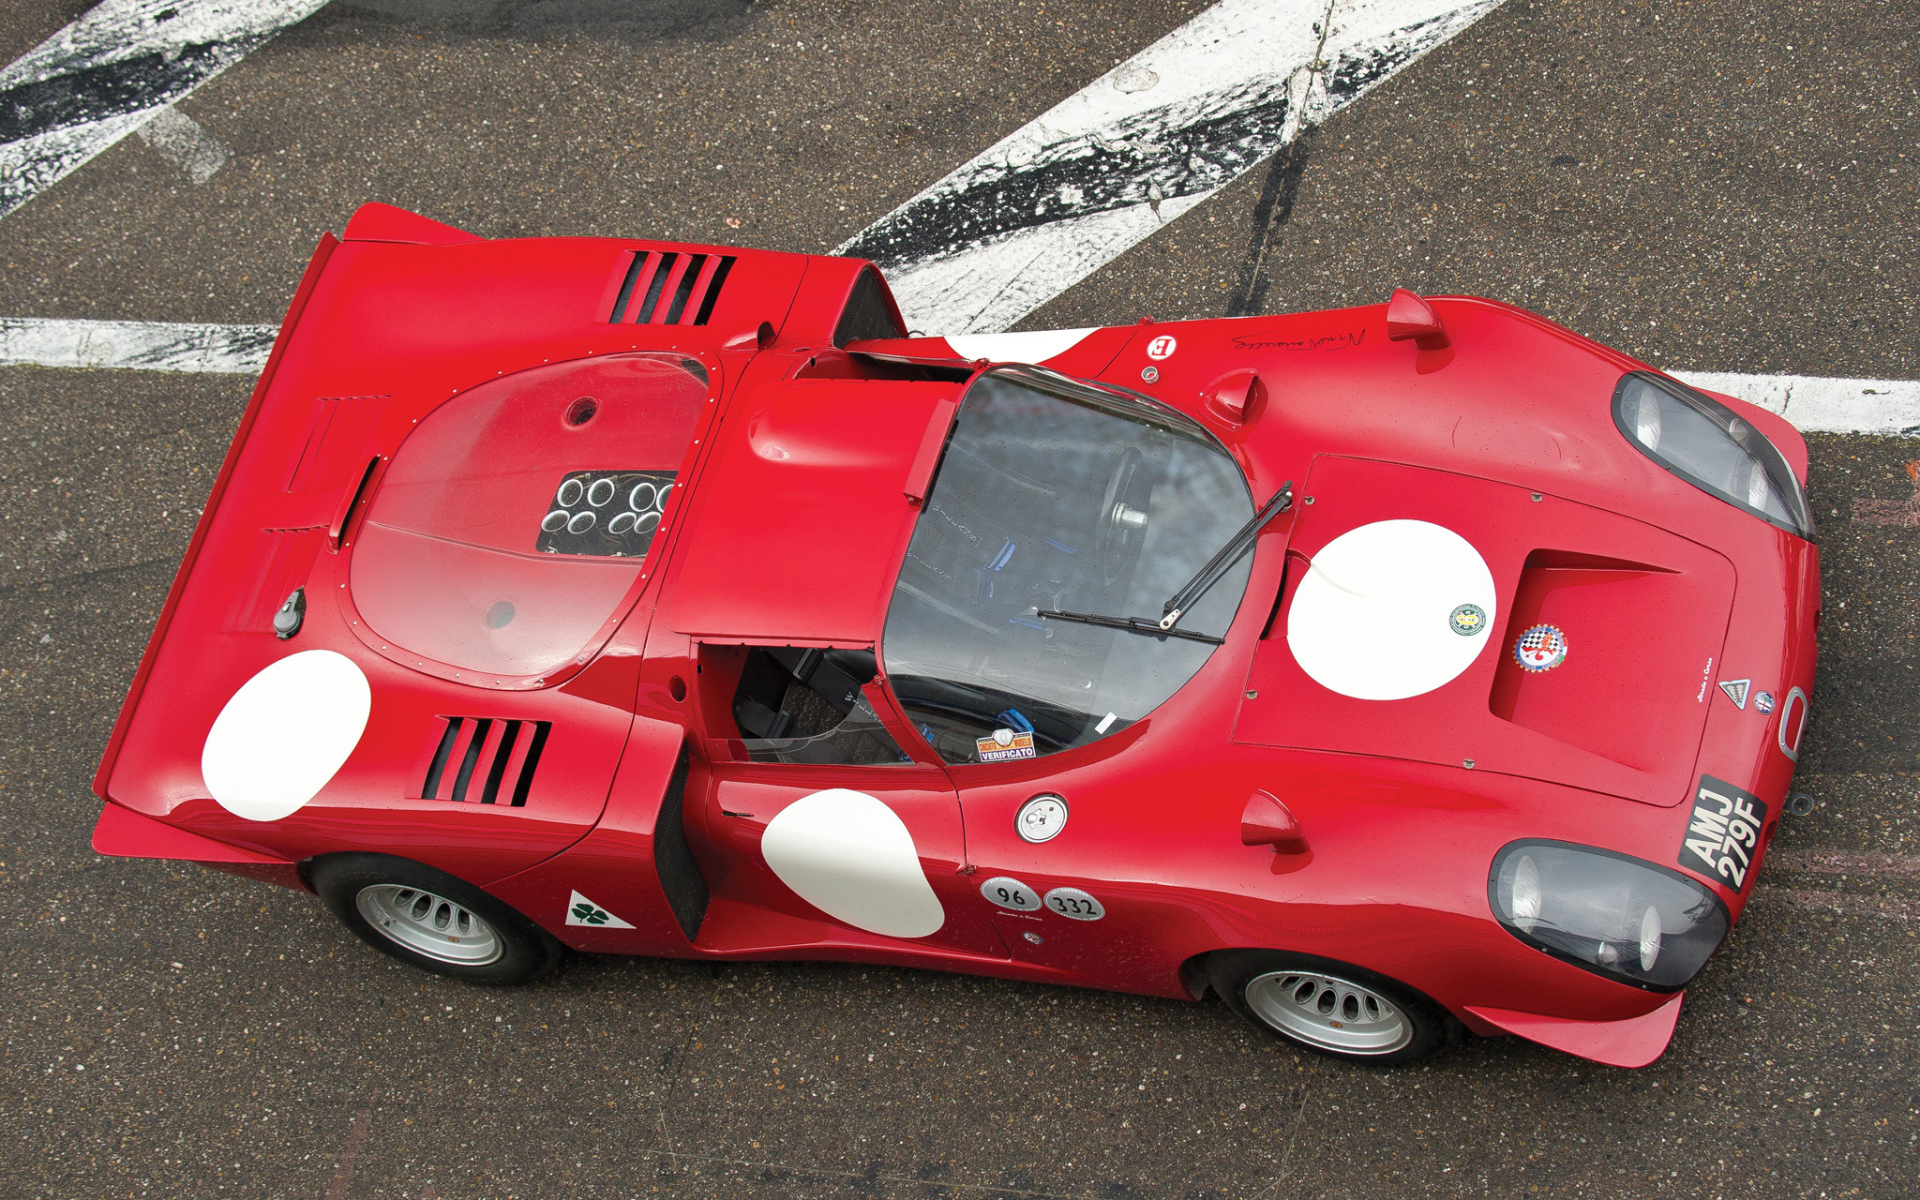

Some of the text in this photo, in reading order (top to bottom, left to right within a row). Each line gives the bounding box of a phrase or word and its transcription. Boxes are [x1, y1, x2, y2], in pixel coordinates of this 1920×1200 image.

[1151, 338, 1173, 356] E
[982, 748, 1033, 760] VERIFICATO
[1684, 787, 1733, 869] AMJ
[1717, 797, 1762, 889] 279F
[997, 887, 1025, 905] 96
[1053, 896, 1097, 915] 332
